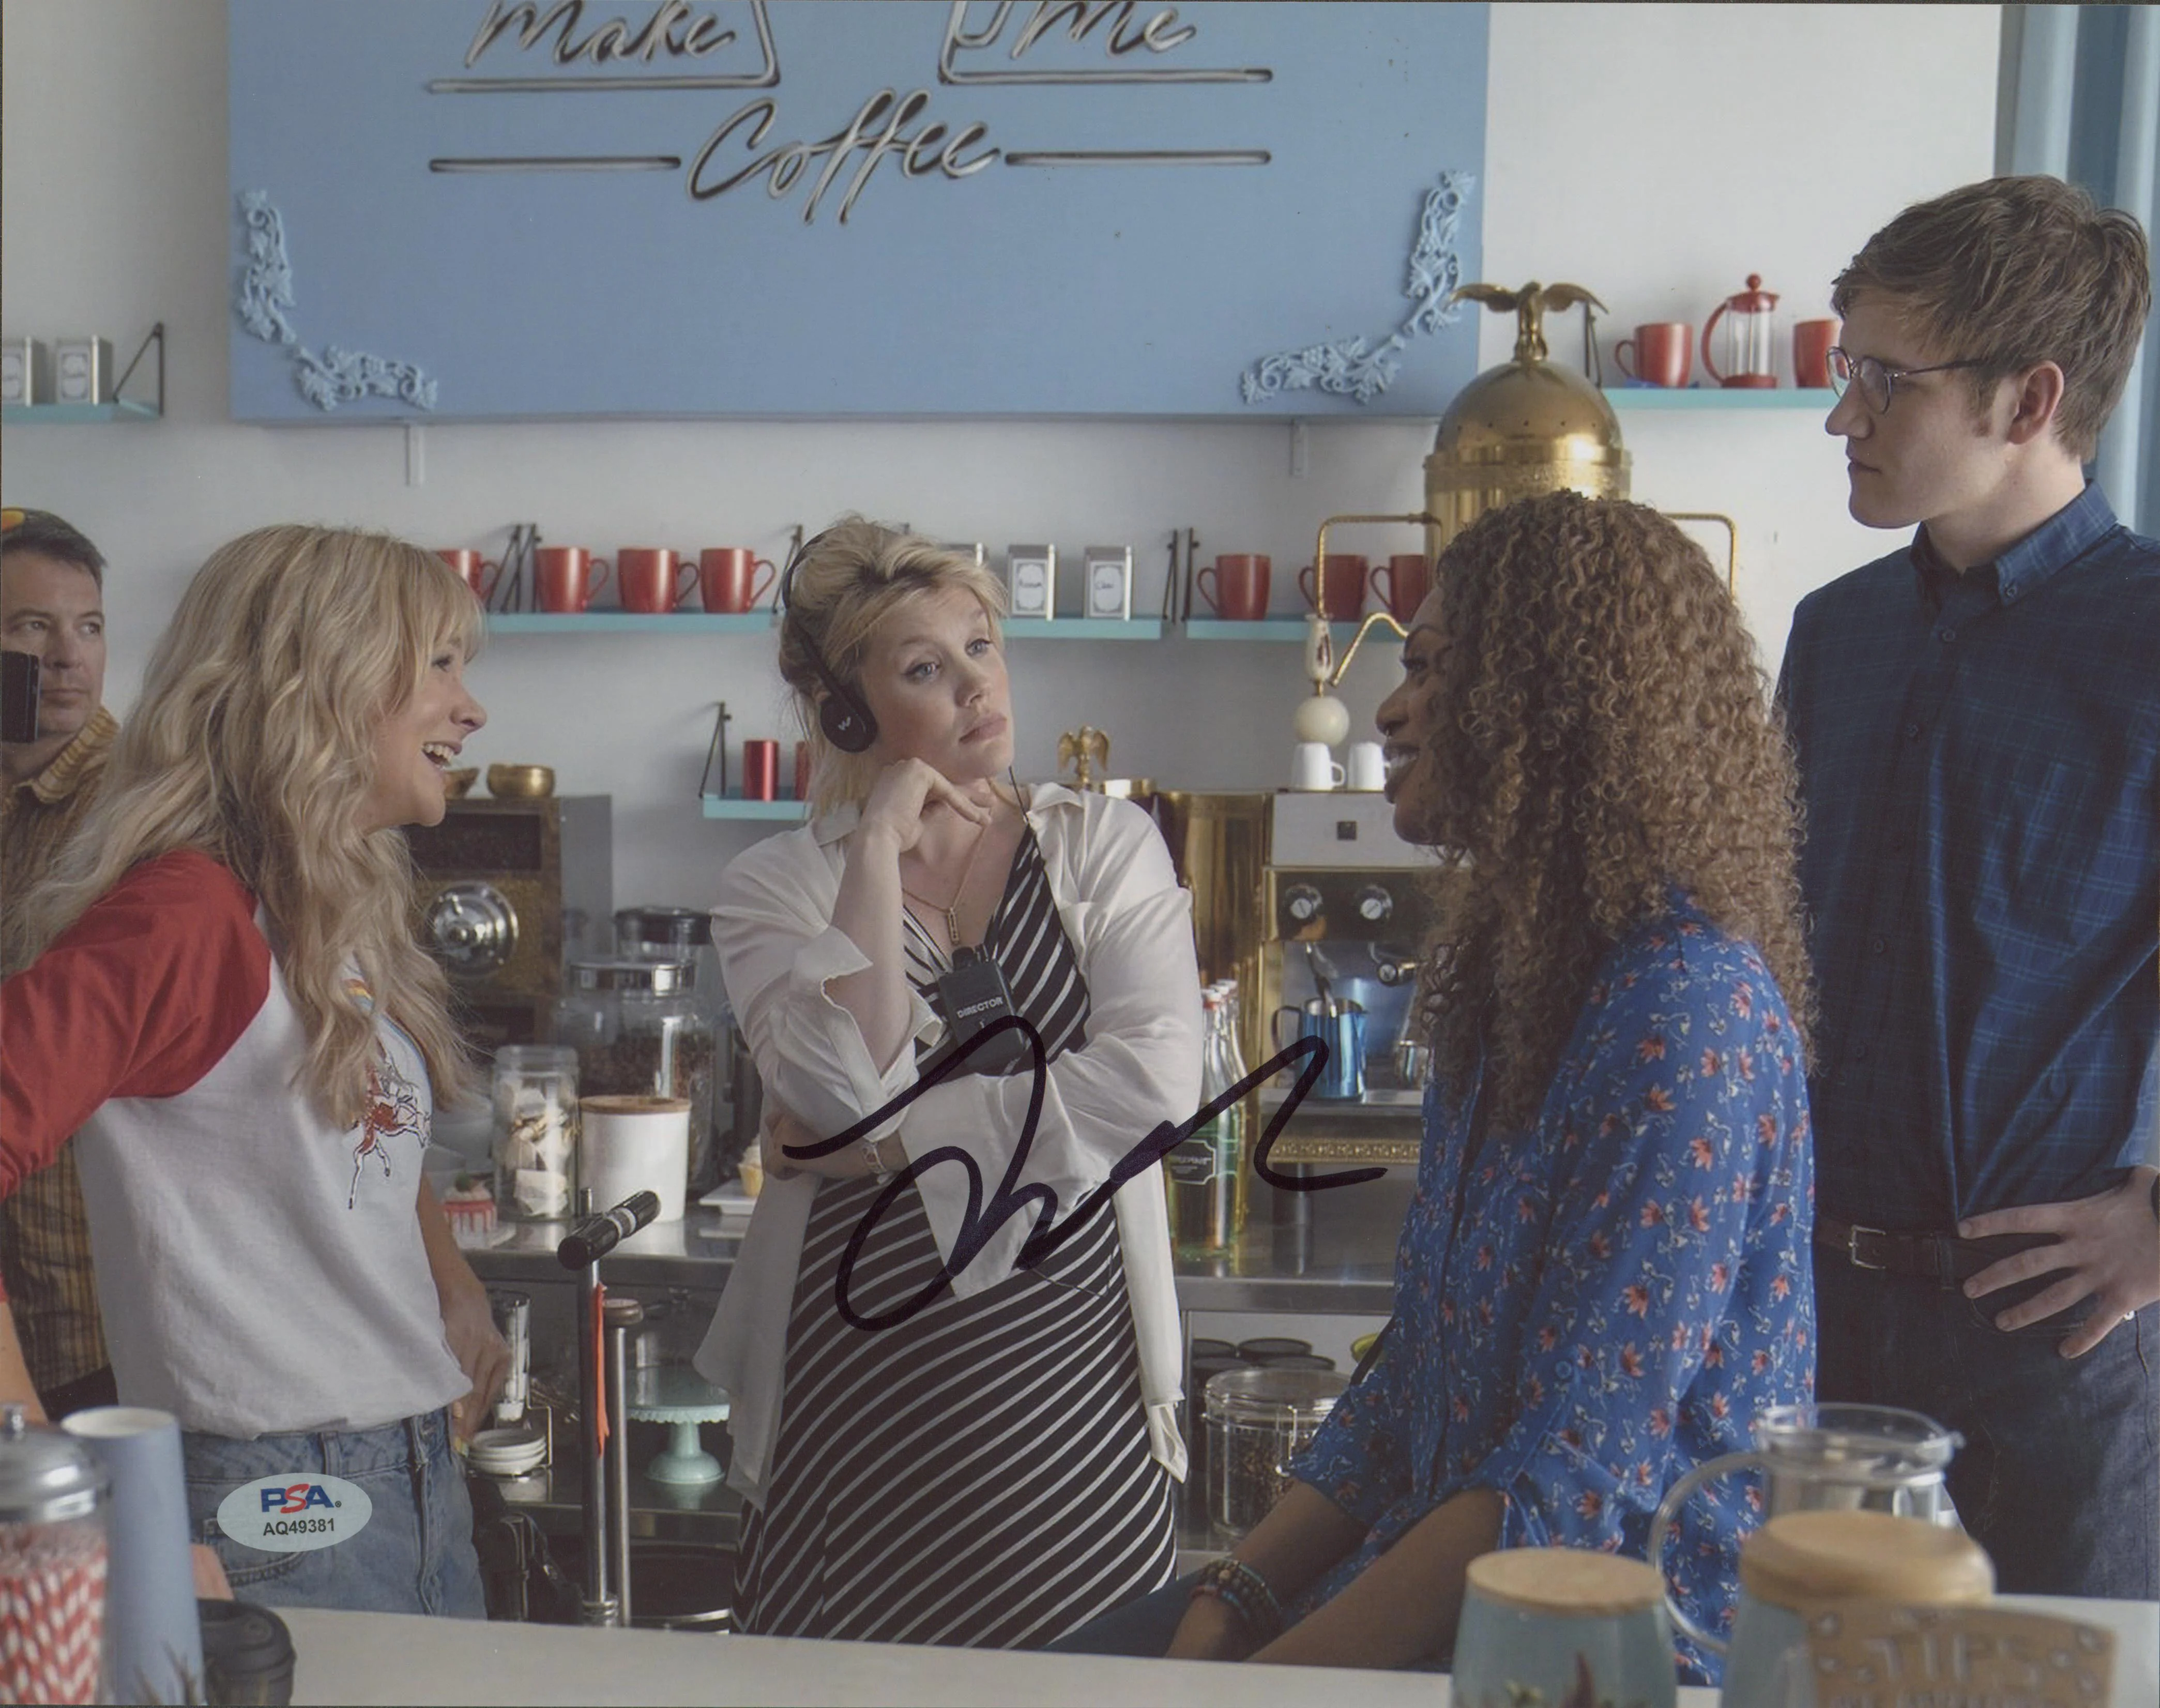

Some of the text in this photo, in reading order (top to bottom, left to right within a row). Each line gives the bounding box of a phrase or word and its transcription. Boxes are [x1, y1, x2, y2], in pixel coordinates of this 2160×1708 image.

[464, 1, 1197, 69] Make Me
[686, 86, 1001, 226] Coffee
[956, 996, 1003, 1019] DIRECTOR
